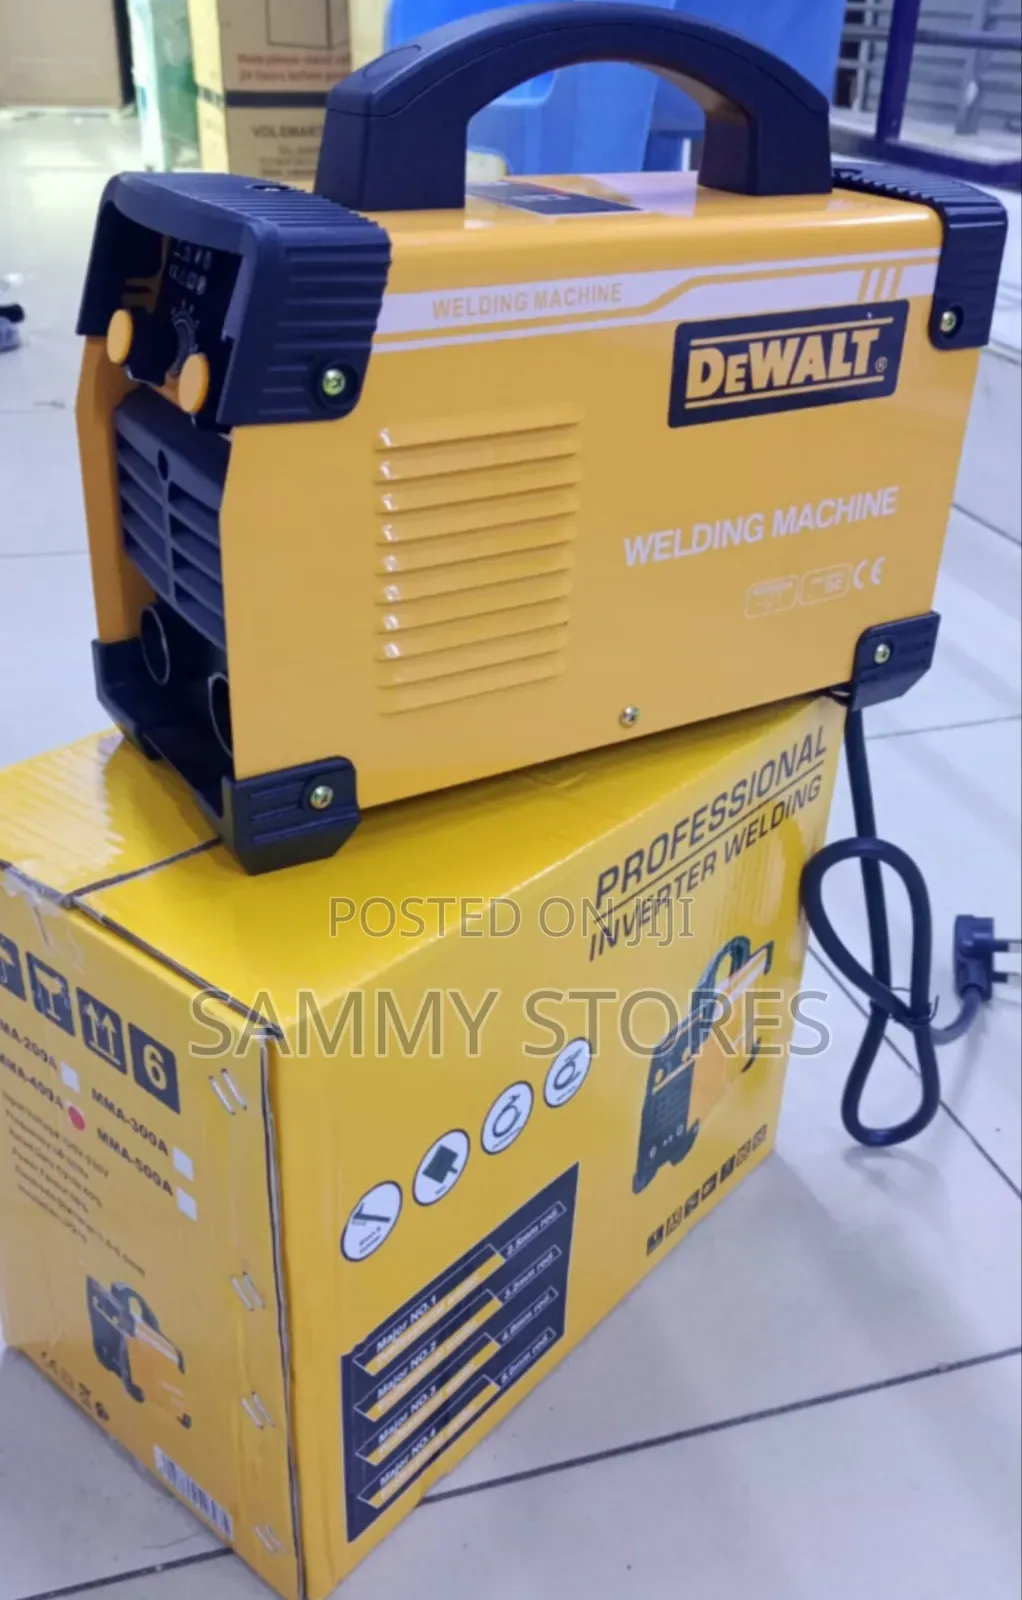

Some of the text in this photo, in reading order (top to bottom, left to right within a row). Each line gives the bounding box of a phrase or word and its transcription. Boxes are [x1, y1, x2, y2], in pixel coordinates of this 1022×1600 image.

[432, 282, 623, 320] WELDING MACHINE
[624, 485, 899, 567] WELDING MACHINE
[595, 726, 827, 909] PROFESSIONAL
[588, 774, 822, 962] INVERTER WELDING
[91, 1087, 169, 1157] MMA-300A
[97, 1127, 174, 1197] MMA-500A
[376, 1321, 408, 1353] Major
[377, 1367, 408, 1399] Major
[378, 1411, 408, 1443] Major
[380, 1454, 409, 1487] Major
